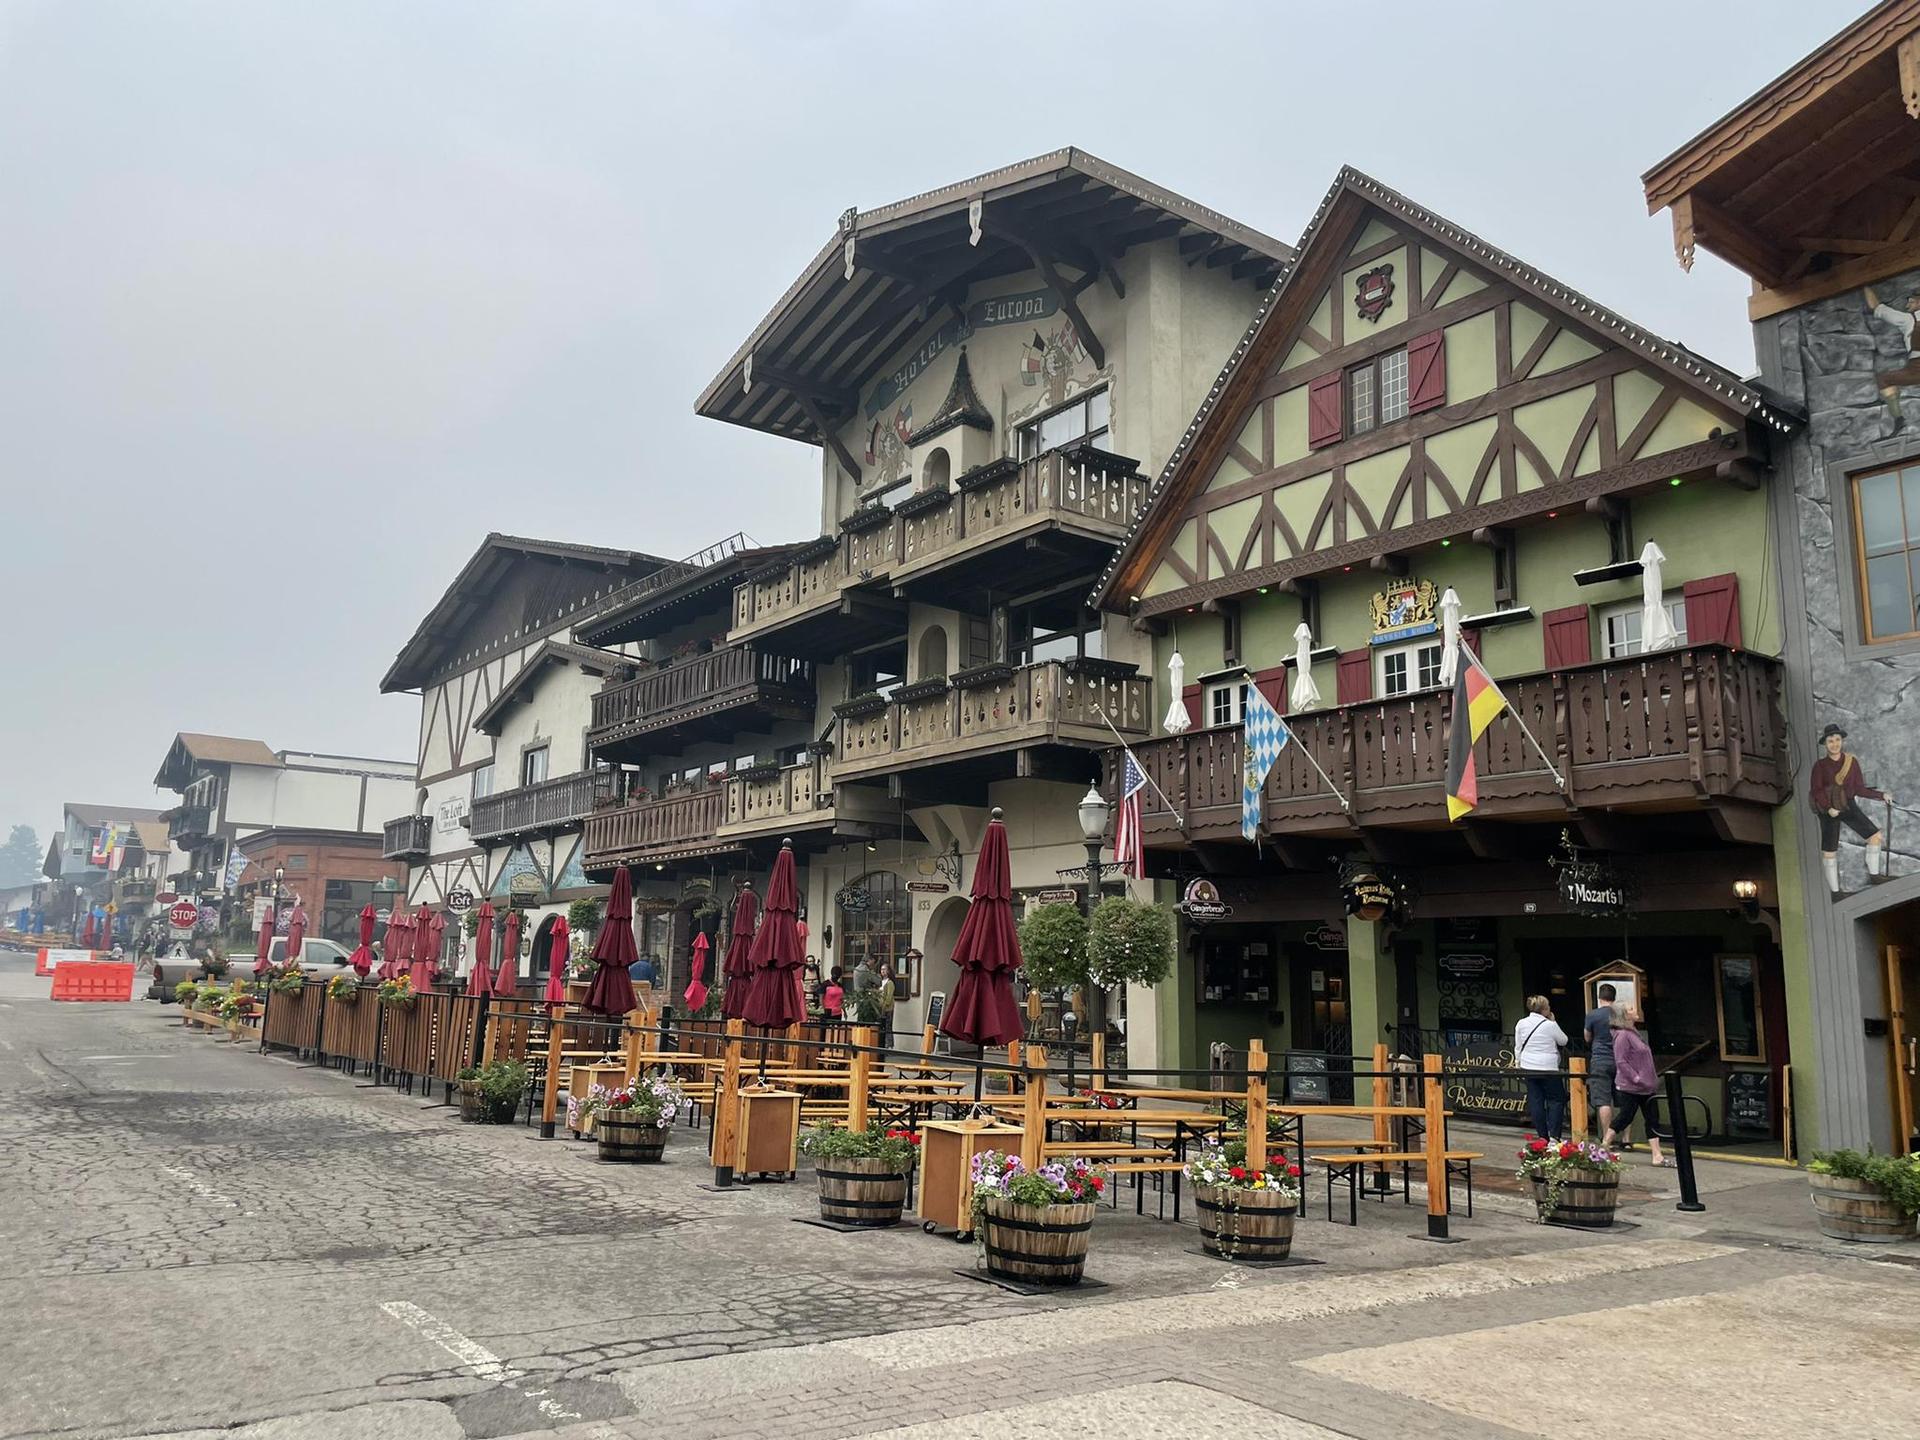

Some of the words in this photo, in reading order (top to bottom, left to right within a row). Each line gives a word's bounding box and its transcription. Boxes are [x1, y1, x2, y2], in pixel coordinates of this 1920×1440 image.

[894, 333, 944, 392] Hotel
[984, 296, 1044, 322] Europa
[450, 896, 471, 906] Loft
[1574, 883, 1617, 905] Mozart's
[171, 909, 197, 920] STOP
[1190, 904, 1225, 914] Gingerbread
[1447, 1085, 1527, 1112] Restaurant
